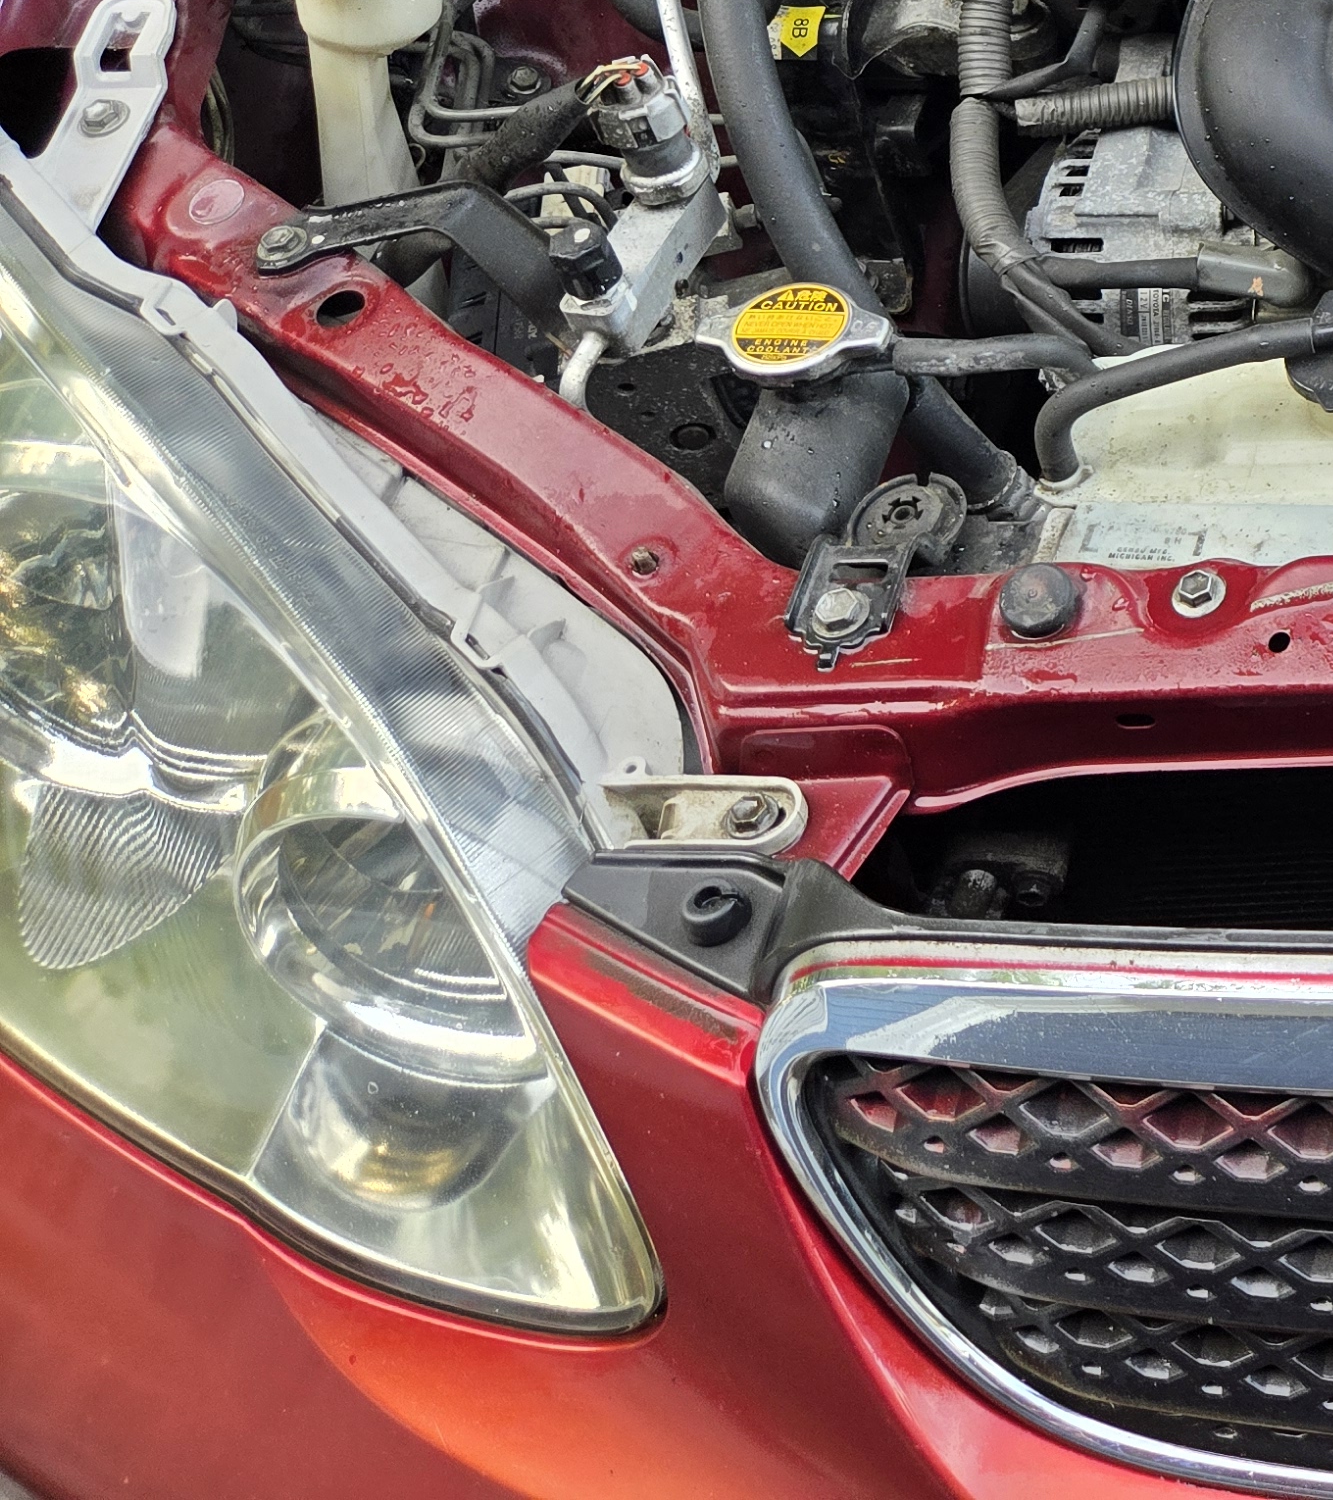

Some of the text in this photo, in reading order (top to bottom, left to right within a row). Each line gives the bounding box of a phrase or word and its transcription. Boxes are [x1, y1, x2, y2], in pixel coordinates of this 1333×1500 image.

[792, 18, 809, 39] 8B
[760, 301, 838, 312] CAUTION
[747, 346, 809, 354] COOLANT
[1108, 553, 1154, 561] MICHIGAN
